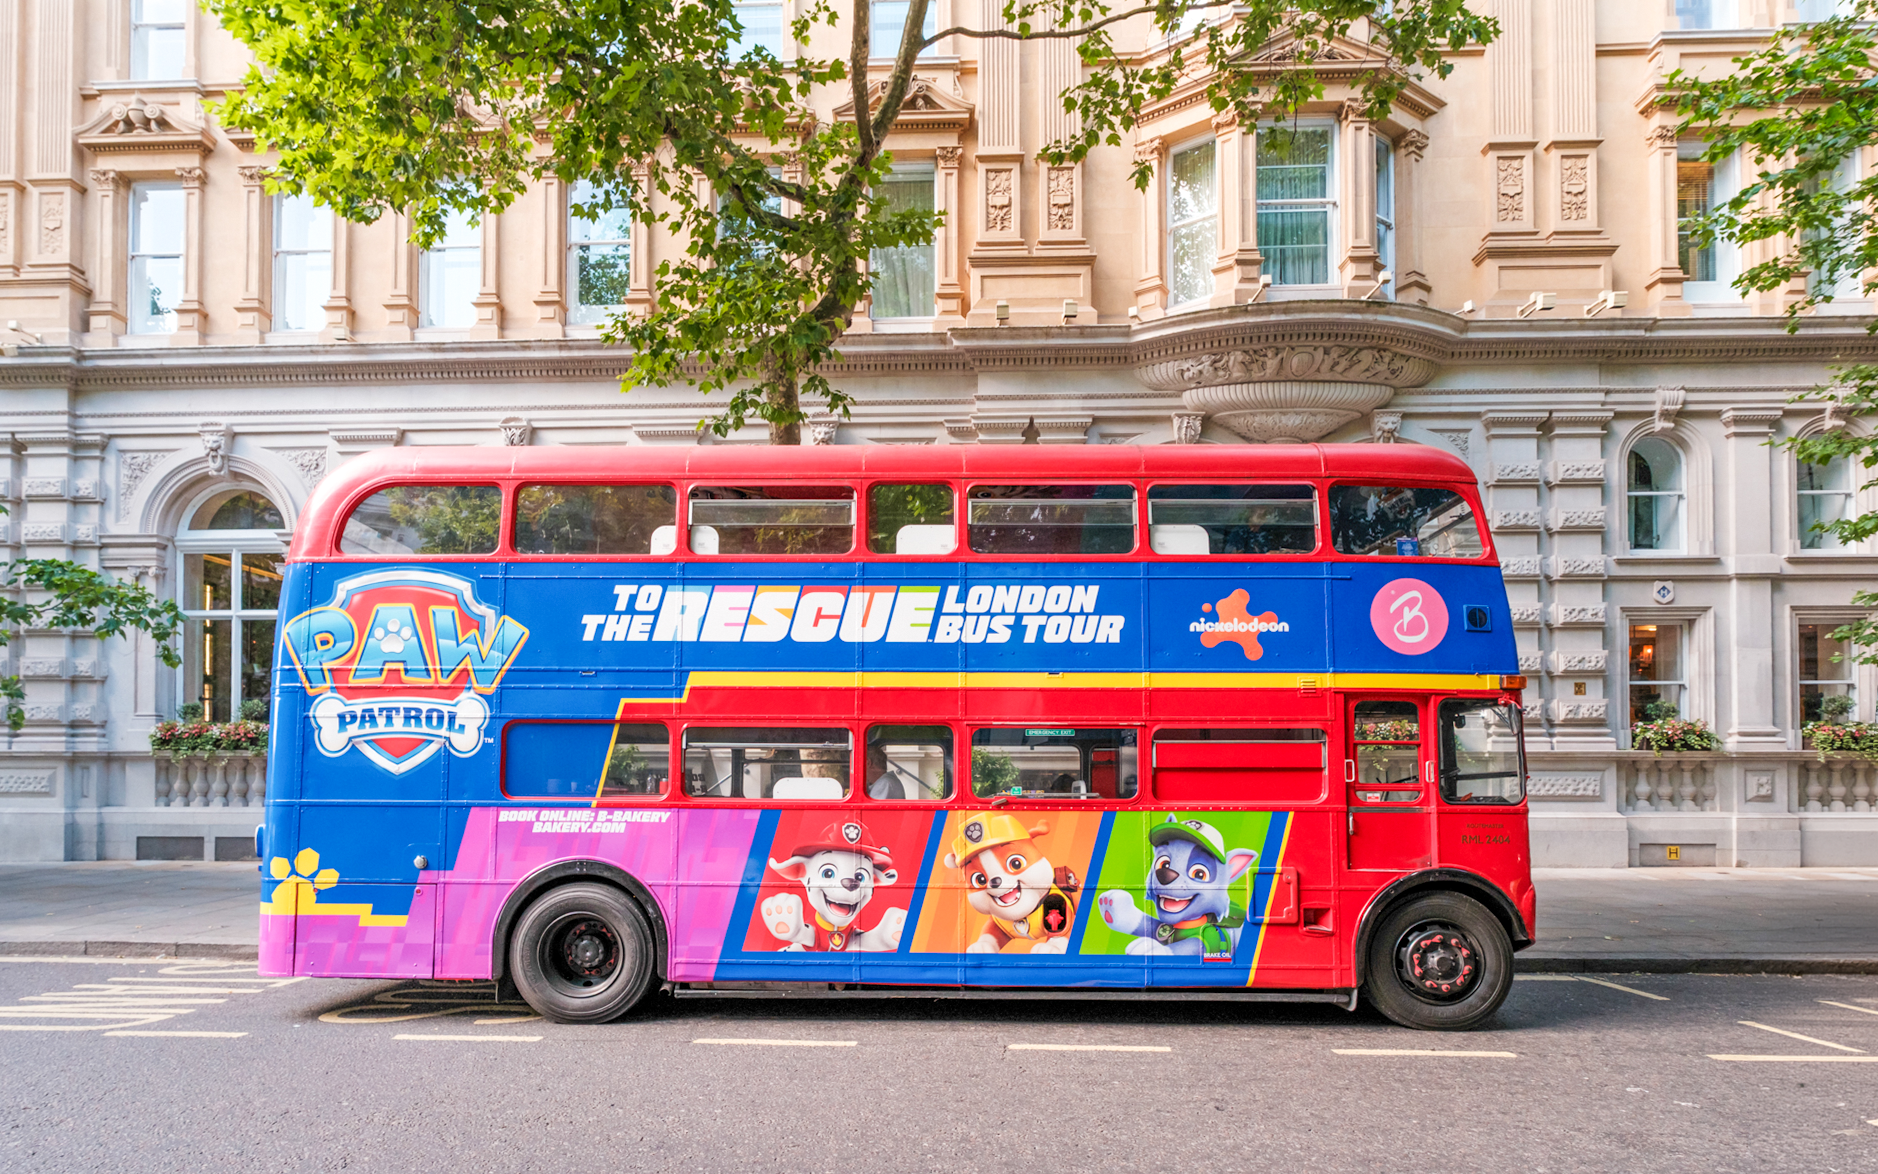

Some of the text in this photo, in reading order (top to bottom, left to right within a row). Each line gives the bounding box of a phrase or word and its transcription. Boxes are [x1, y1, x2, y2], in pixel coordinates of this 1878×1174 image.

[613, 585, 663, 611] TO
[942, 585, 1100, 613] LONDON
[581, 585, 941, 642] THE RESCUE
[1189, 617, 1290, 632] nickelodeon
[1390, 590, 1429, 643] B
[934, 615, 1126, 643] BUS TOUR
[283, 602, 530, 695] PAW
[336, 706, 466, 735] PATROL
[498, 810, 671, 823] BOOK ONLINE: B-BAKERY
[532, 822, 627, 833] BAKERY.COM
[1461, 835, 1511, 844] RML 2404
[1668, 848, 1678, 858] H
